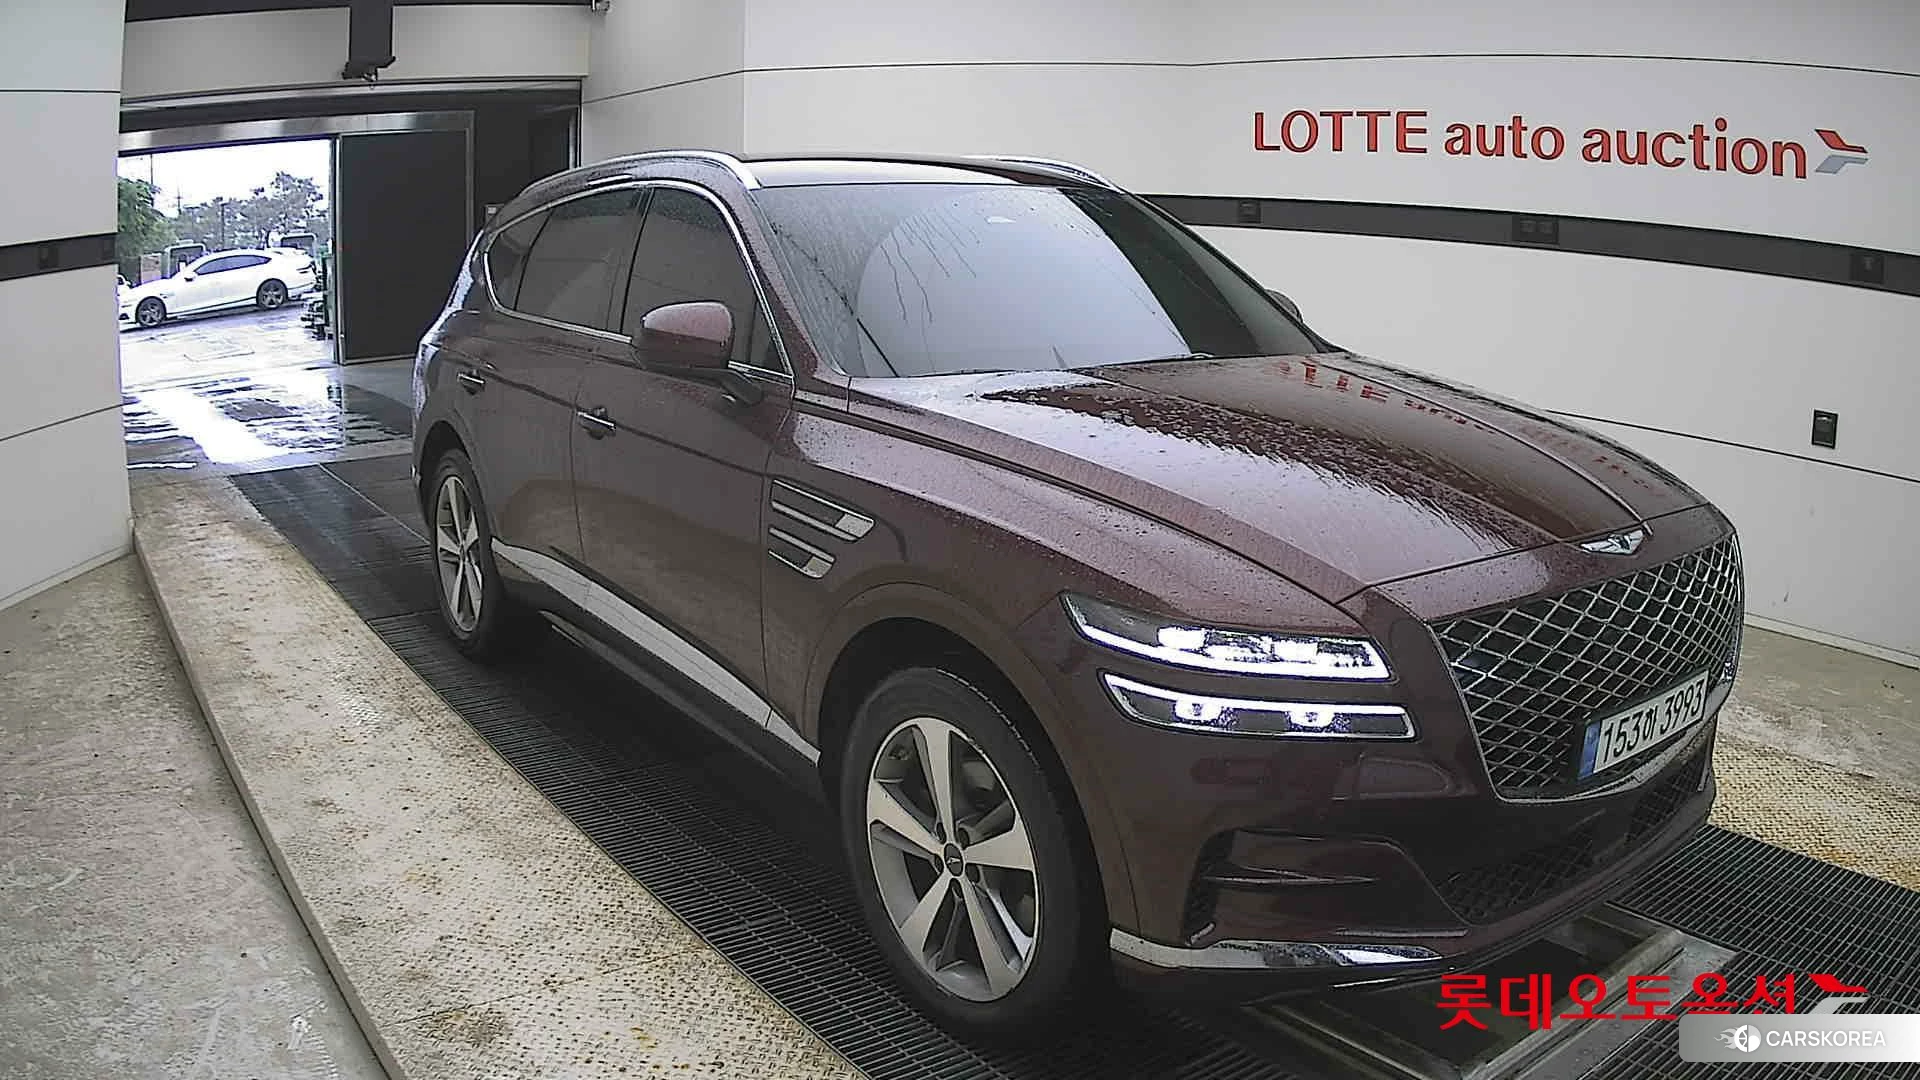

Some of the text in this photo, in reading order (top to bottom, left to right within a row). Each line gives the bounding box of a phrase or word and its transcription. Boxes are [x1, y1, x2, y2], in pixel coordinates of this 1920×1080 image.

[1253, 110, 1807, 178] LOTTE auto auction
[1660, 680, 1705, 734] 3993
